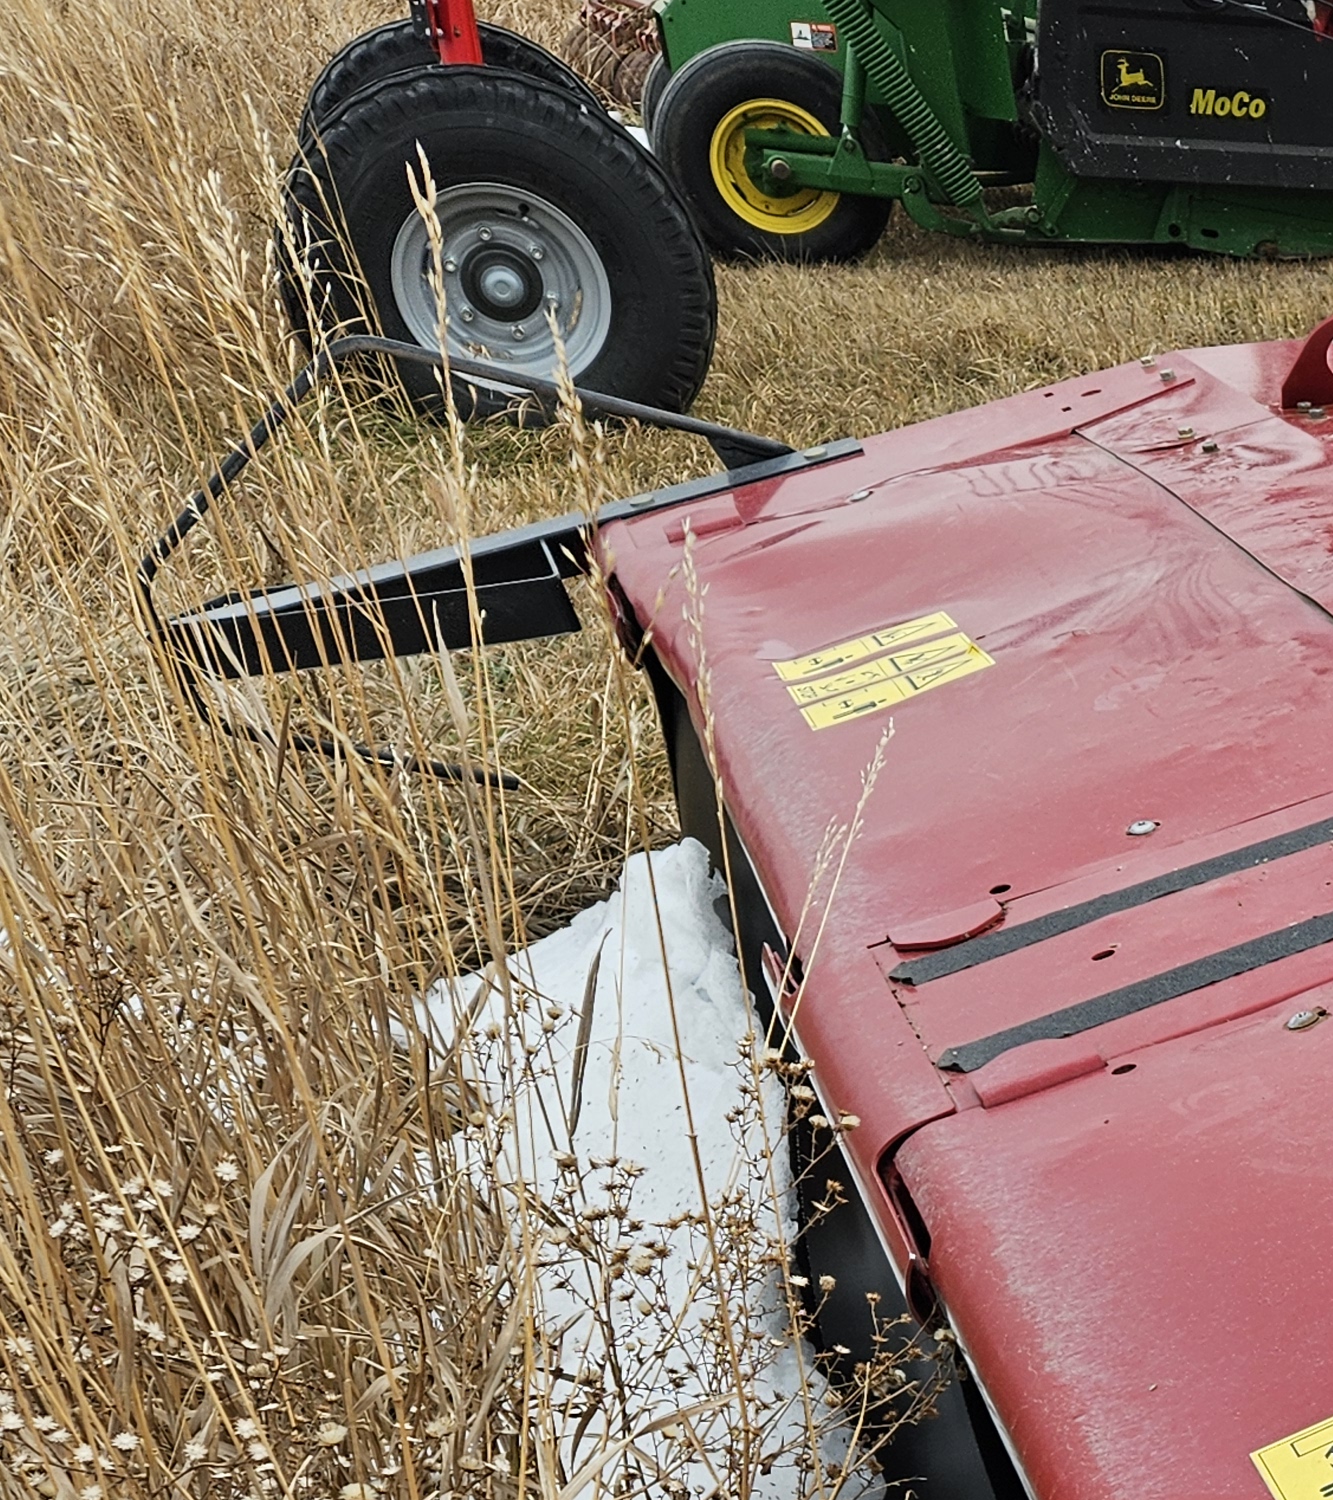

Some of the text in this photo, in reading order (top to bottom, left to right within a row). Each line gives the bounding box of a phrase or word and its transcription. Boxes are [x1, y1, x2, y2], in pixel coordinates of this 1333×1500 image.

[1109, 93, 1156, 104] JOHN DEERE
[1190, 88, 1266, 118] MoCo
